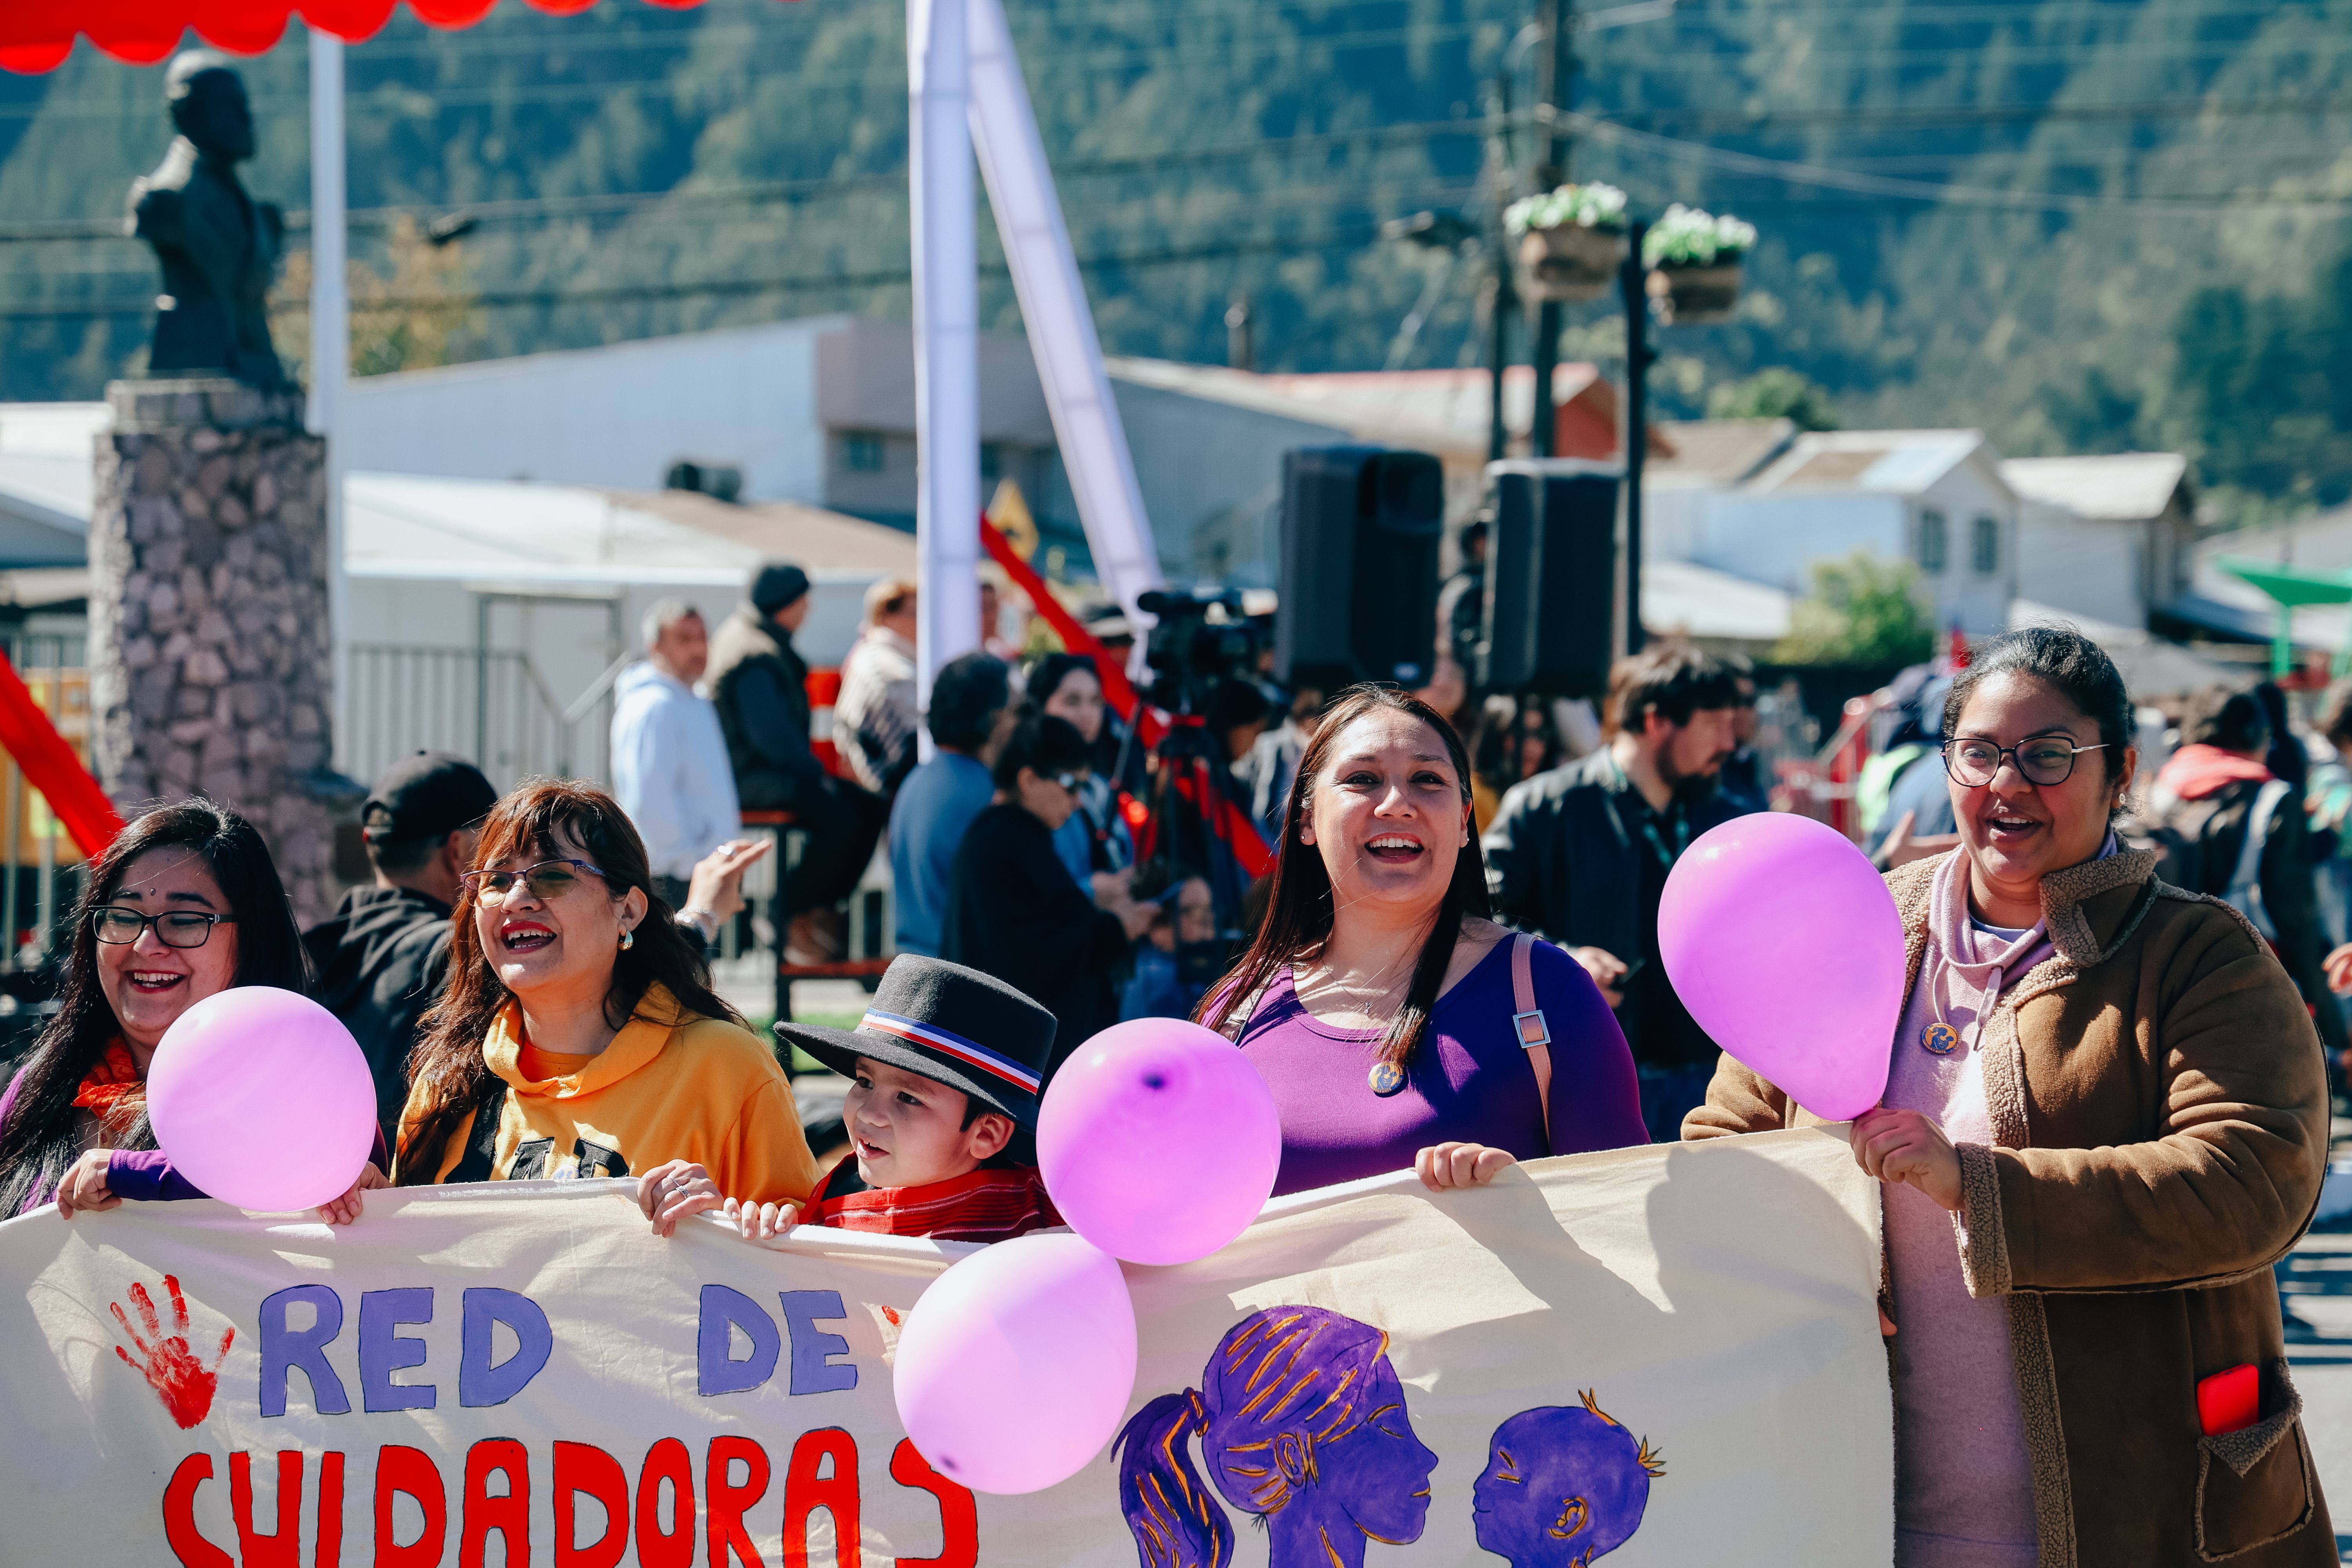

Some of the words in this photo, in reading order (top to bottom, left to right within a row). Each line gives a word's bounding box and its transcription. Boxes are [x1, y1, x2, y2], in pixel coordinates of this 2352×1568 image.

[259, 1284, 553, 1417] RED
[698, 1284, 859, 1396] DE
[162, 1426, 978, 1568] CUIDADORAS
